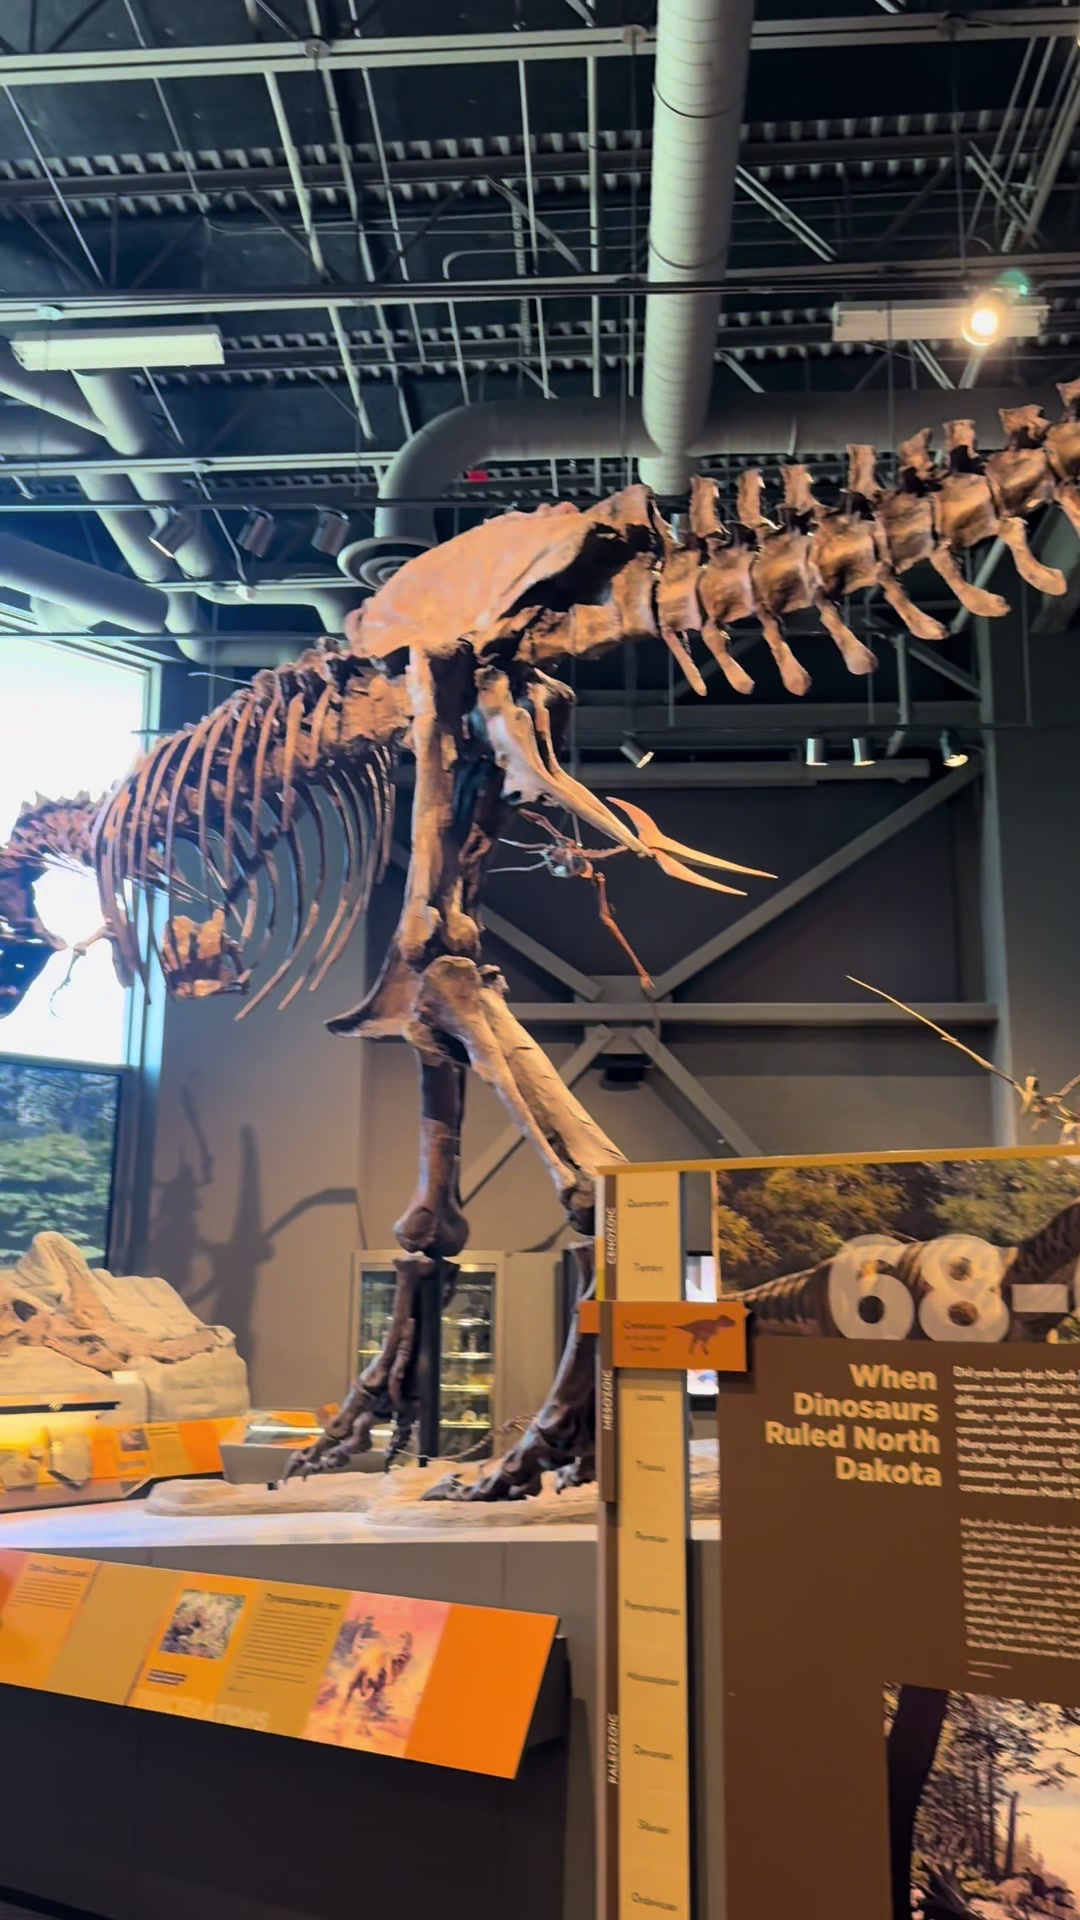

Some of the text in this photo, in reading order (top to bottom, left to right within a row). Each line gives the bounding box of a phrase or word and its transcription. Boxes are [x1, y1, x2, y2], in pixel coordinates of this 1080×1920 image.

[829, 1233, 1080, 1343] 68-
[849, 1364, 938, 1391] When
[793, 1392, 940, 1422] Dinosaurs
[765, 1421, 941, 1455] Ruled North
[835, 1456, 942, 1487] Dakota
